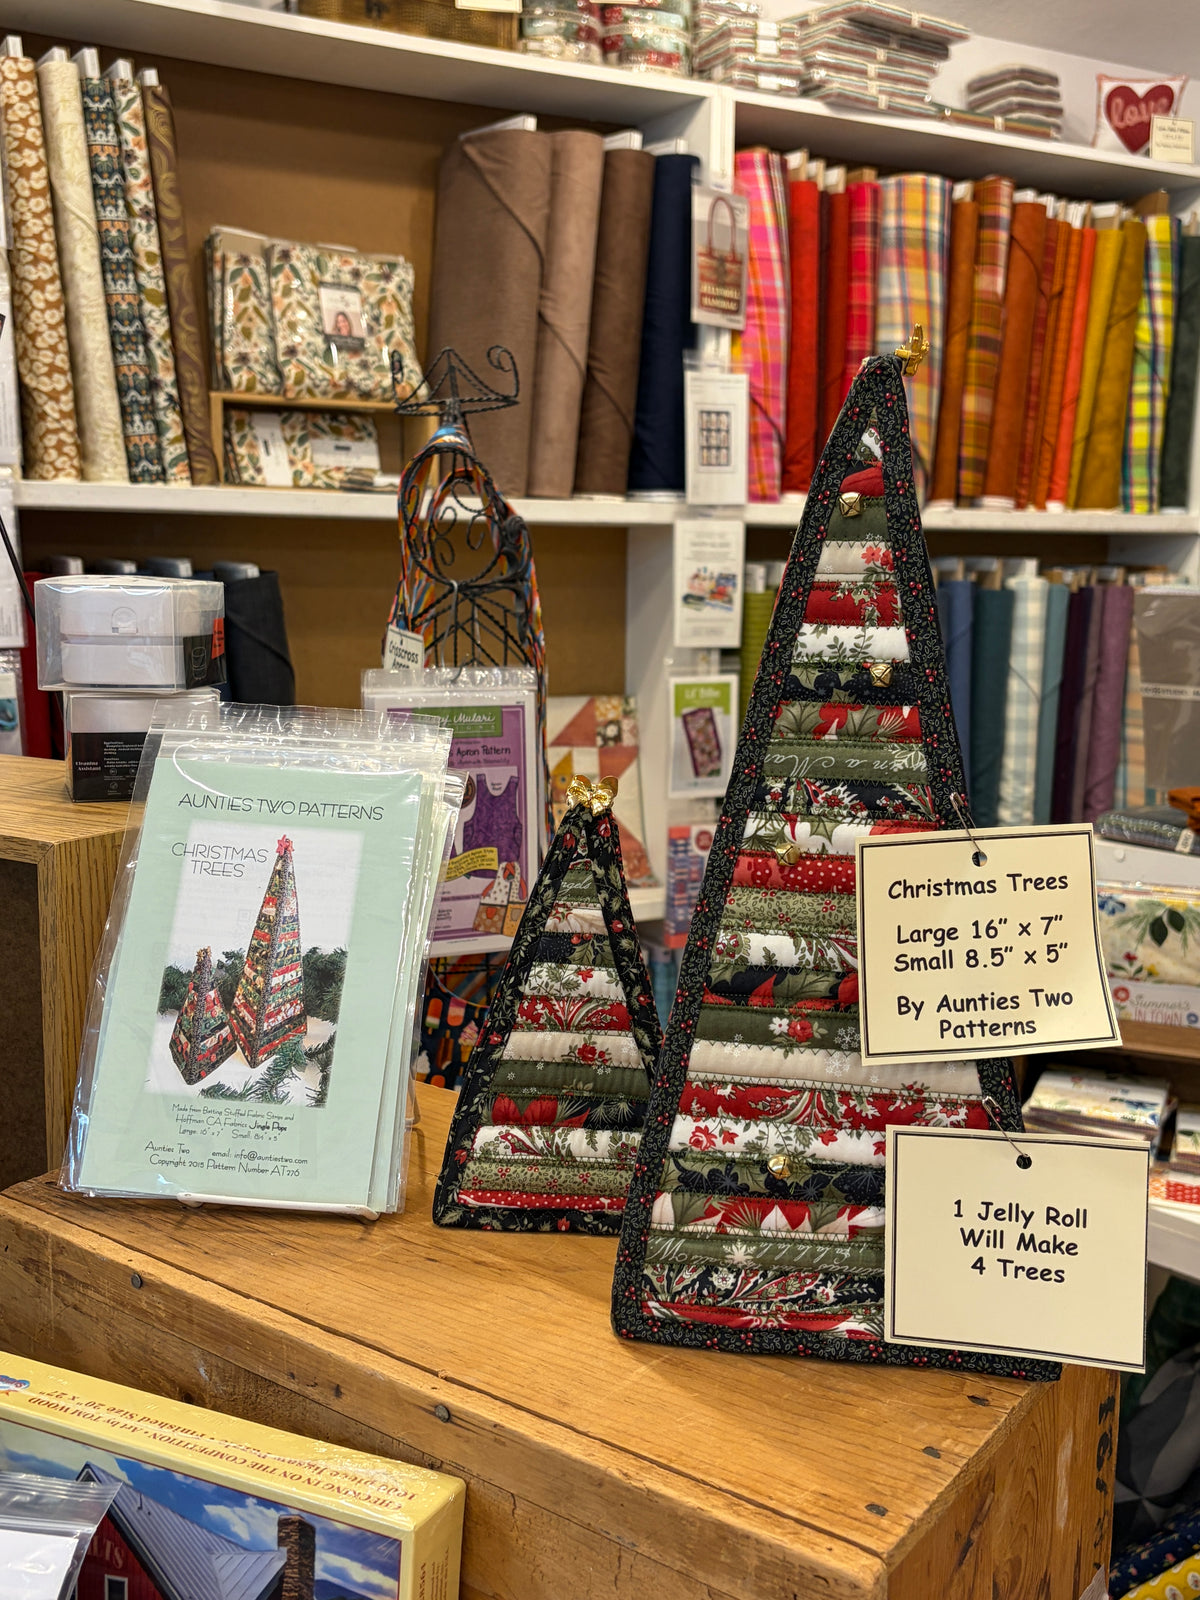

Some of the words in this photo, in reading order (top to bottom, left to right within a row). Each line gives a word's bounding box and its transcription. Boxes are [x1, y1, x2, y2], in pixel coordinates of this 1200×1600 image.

[453, 711, 495, 723] Mulari
[456, 746, 480, 759] Apron
[480, 744, 511, 757] Pattern
[178, 793, 254, 812] AUNTIES
[256, 798, 296, 815] TWO
[298, 801, 385, 821] PATTERNS
[171, 842, 269, 863] CHRISTMAS
[191, 860, 246, 878] TREES
[888, 878, 997, 900] Christmas
[1006, 873, 1069, 892] Trees
[897, 924, 959, 947] Large
[971, 917, 1008, 939] 16"
[1018, 922, 1032, 937] x
[1040, 914, 1063, 936] 7"
[894, 949, 954, 972] Small
[965, 945, 1014, 969] 8.5"
[1023, 950, 1037, 965] x
[1046, 942, 1068, 964] 5"
[897, 995, 925, 1021] By
[936, 992, 1020, 1013] Aunties
[1028, 988, 1074, 1008] Two
[1134, 1007, 1146, 1022] IN
[1150, 1008, 1183, 1027] TOWN
[939, 1019, 1038, 1039] Patterns
[172, 1103, 188, 1112] Made
[189, 1104, 202, 1113] from
[203, 1106, 223, 1116] Batting
[224, 1107, 246, 1117] Stuffed
[247, 1109, 265, 1119] Fabric
[284, 1113, 295, 1121] and
[176, 1114, 205, 1124] Hoffman
[206, 1116, 222, 1127] CA
[224, 1117, 247, 1128] Fabrics
[249, 1120, 271, 1131] Jingle
[271, 1121, 288, 1132] Pops
[144, 1141, 174, 1153] Aunties
[177, 1142, 190, 1154] Two
[211, 1148, 232, 1158] email:
[234, 1149, 308, 1165] info@auntiestwo.com
[149, 1153, 187, 1168] Copyright
[188, 1160, 204, 1169] 2015
[206, 1159, 236, 1171] Pattern
[238, 1162, 270, 1174] Number
[953, 1199, 964, 1218] 1
[977, 1201, 1035, 1230] Jelly
[1045, 1206, 1088, 1229] Roll
[960, 1227, 1004, 1249] Will
[1016, 1232, 1079, 1256] Make
[970, 1256, 986, 1275] 4
[996, 1258, 1066, 1283] Trees
[28, 1396, 71, 1416] WOOD
[67, 1394, 80, 1404] x
[70, 1408, 103, 1422] TOM
[104, 1417, 120, 1428] by
[107, 1405, 138, 1421] Size
[120, 1422, 144, 1434] Art
[138, 1416, 207, 1439] Finished
[149, 1430, 247, 1469] COMPETITION
[247, 1461, 277, 1475] THE
[279, 1471, 301, 1481] ON
[300, 1476, 321, 1487] IN
[330, 1469, 375, 1488] piece
[321, 1482, 402, 1511] CHECKING
